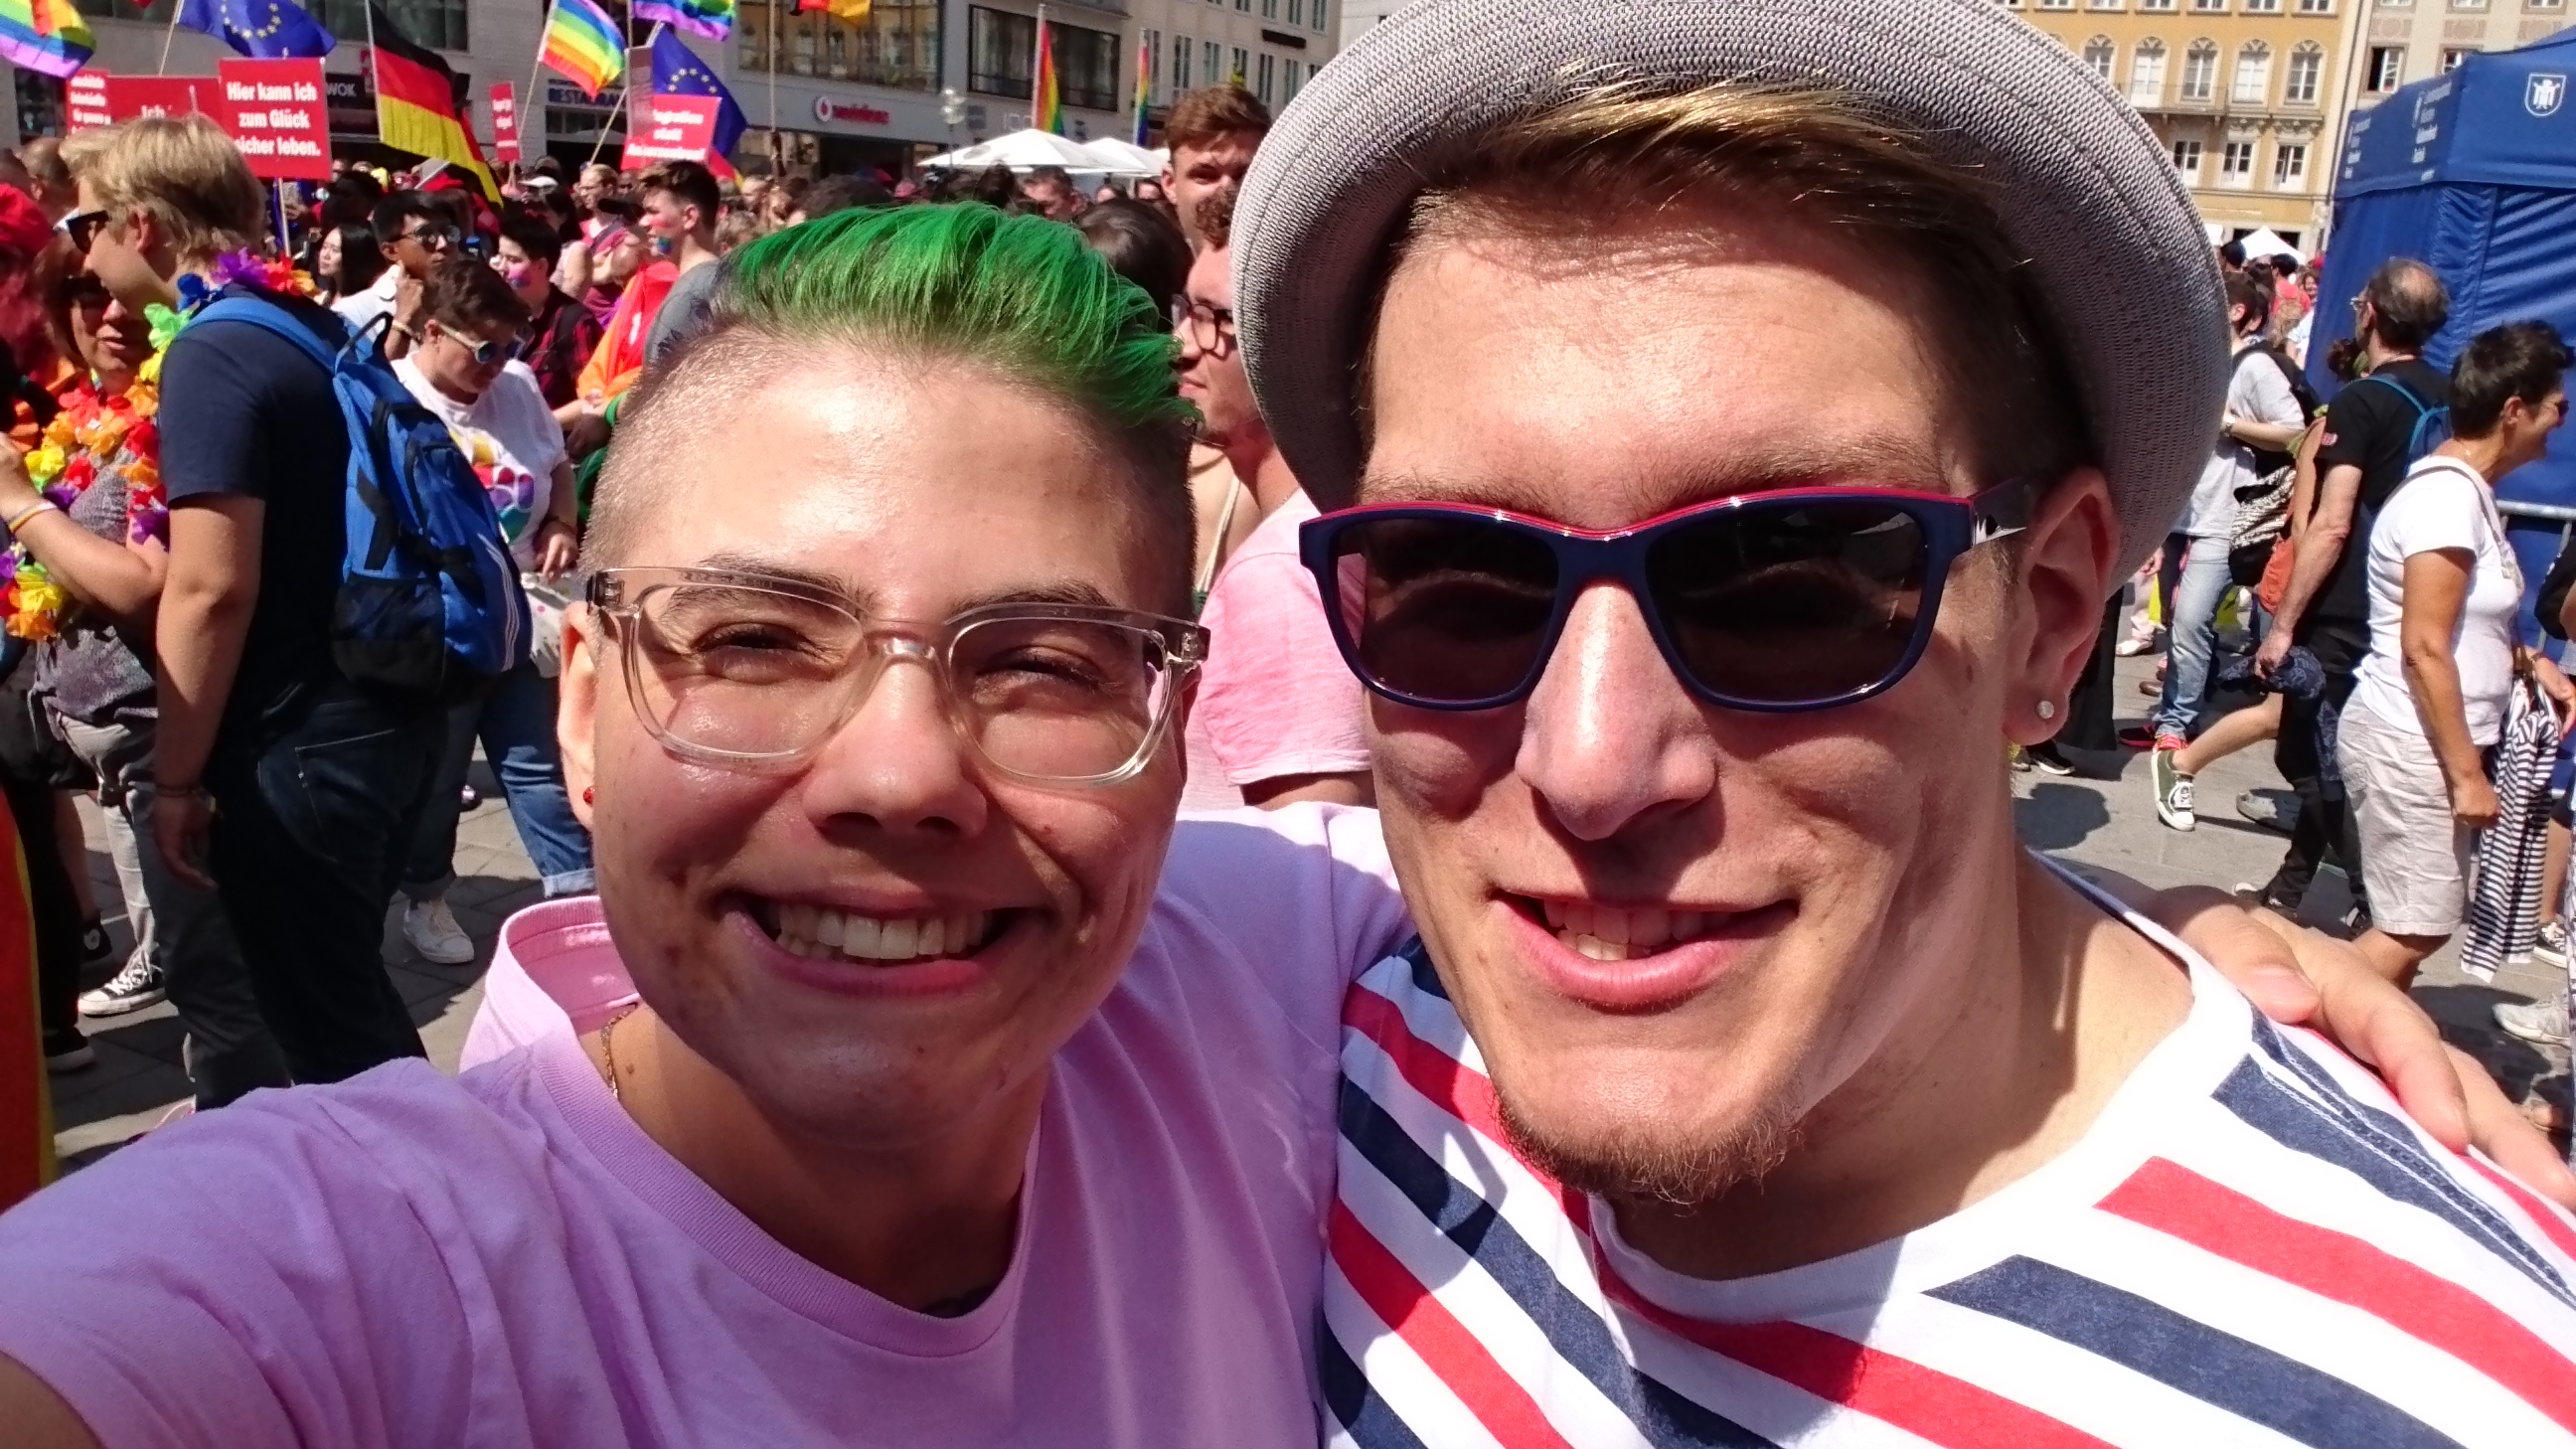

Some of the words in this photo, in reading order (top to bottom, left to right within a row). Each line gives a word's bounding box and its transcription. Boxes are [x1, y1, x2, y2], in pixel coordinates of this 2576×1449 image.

[227, 81, 255, 101] Hier
[257, 81, 292, 101] kann
[293, 81, 317, 101] ich
[239, 111, 267, 128] zum
[269, 108, 310, 128] Glück
[276, 136, 321, 156] leben.
